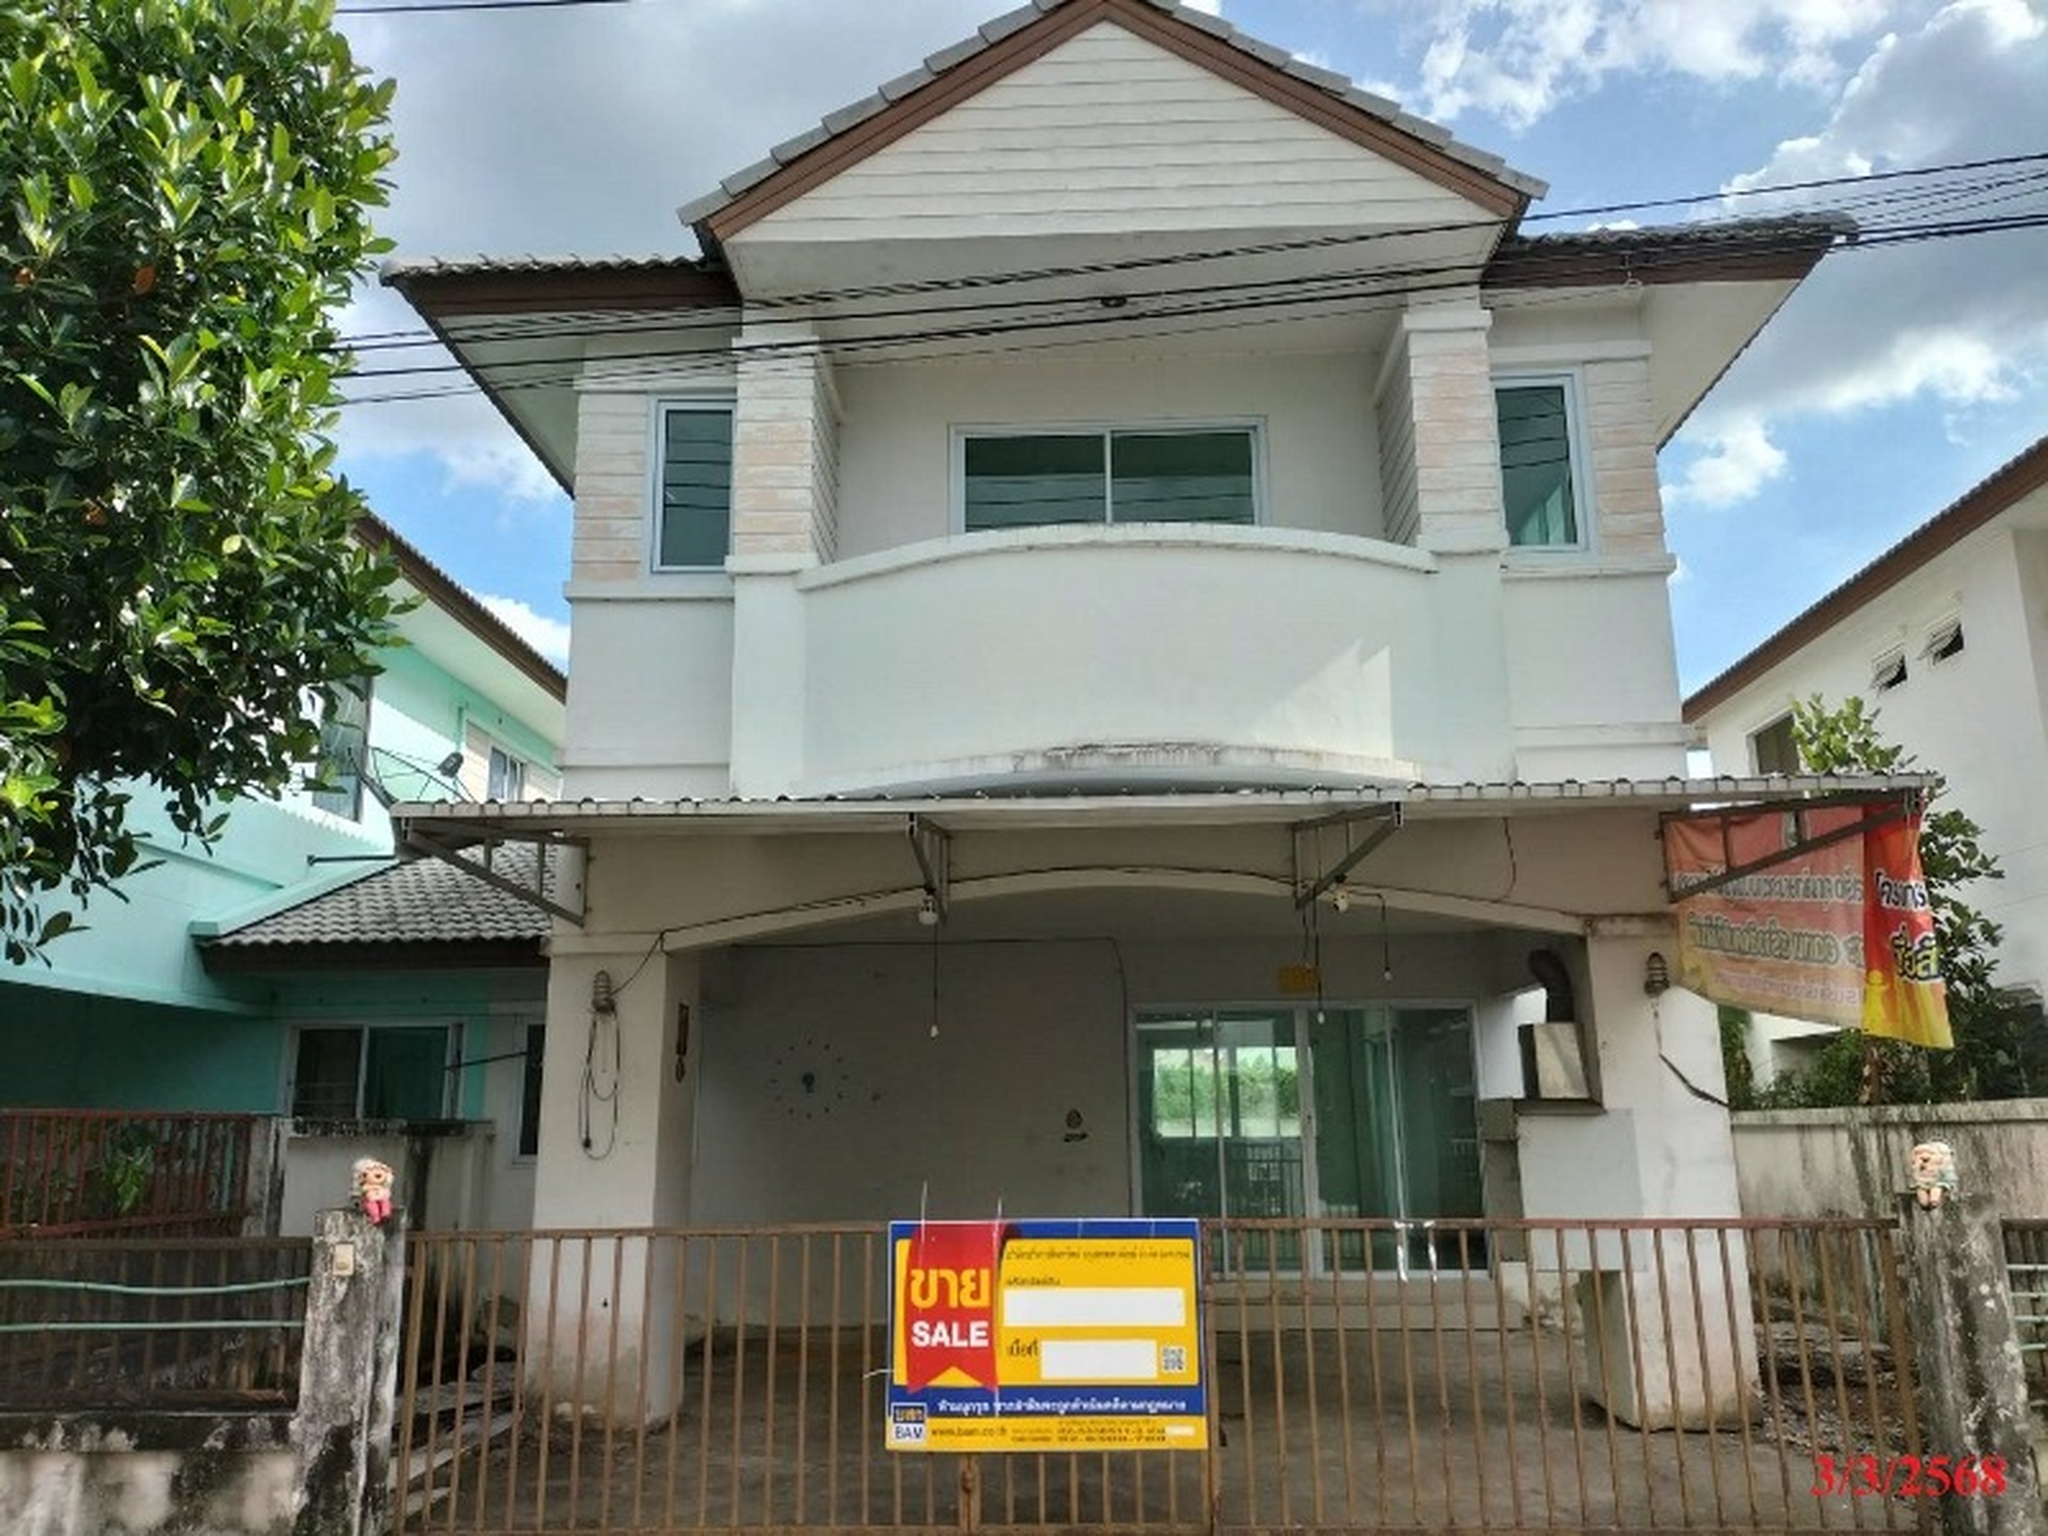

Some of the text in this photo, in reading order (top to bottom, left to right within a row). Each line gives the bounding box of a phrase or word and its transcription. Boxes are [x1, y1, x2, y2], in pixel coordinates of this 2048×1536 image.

[910, 1268, 989, 1309] ขาย
[911, 1320, 989, 1348] SALE
[895, 1426, 923, 1439] BAM
